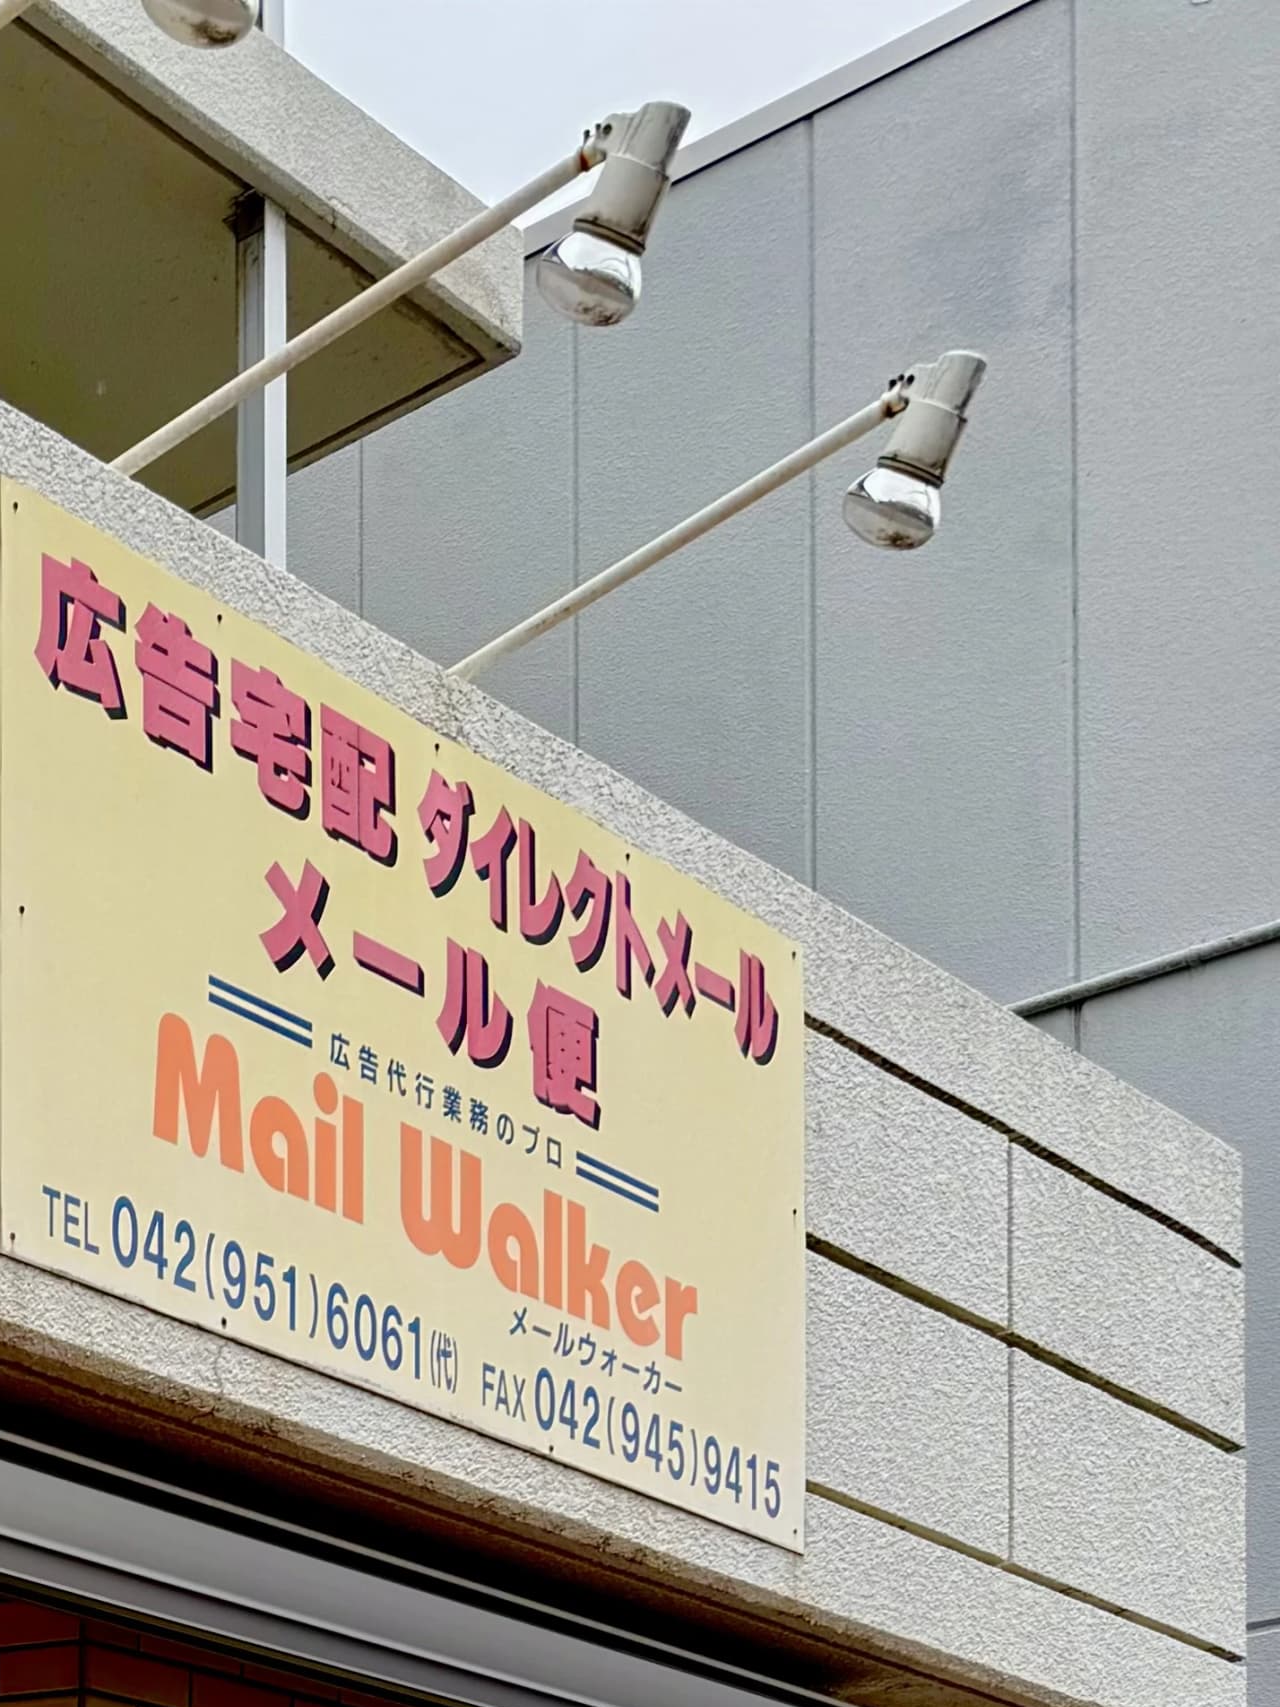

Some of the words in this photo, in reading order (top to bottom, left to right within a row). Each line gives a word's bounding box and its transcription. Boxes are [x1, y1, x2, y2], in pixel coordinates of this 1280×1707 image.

[33, 549, 398, 867] 広告宅配
[416, 767, 779, 1066] ダイレクトメール
[258, 858, 602, 1130] メール便
[328, 1030, 564, 1170] 広告代行業務のプロ
[151, 1011, 366, 1225] Mail
[399, 1134, 699, 1362] Walker
[41, 1183, 101, 1257] TEL
[479, 1361, 526, 1424] FAX
[533, 1364, 782, 1521] 042(945)9415
[508, 1304, 682, 1396] メールウォーカー
